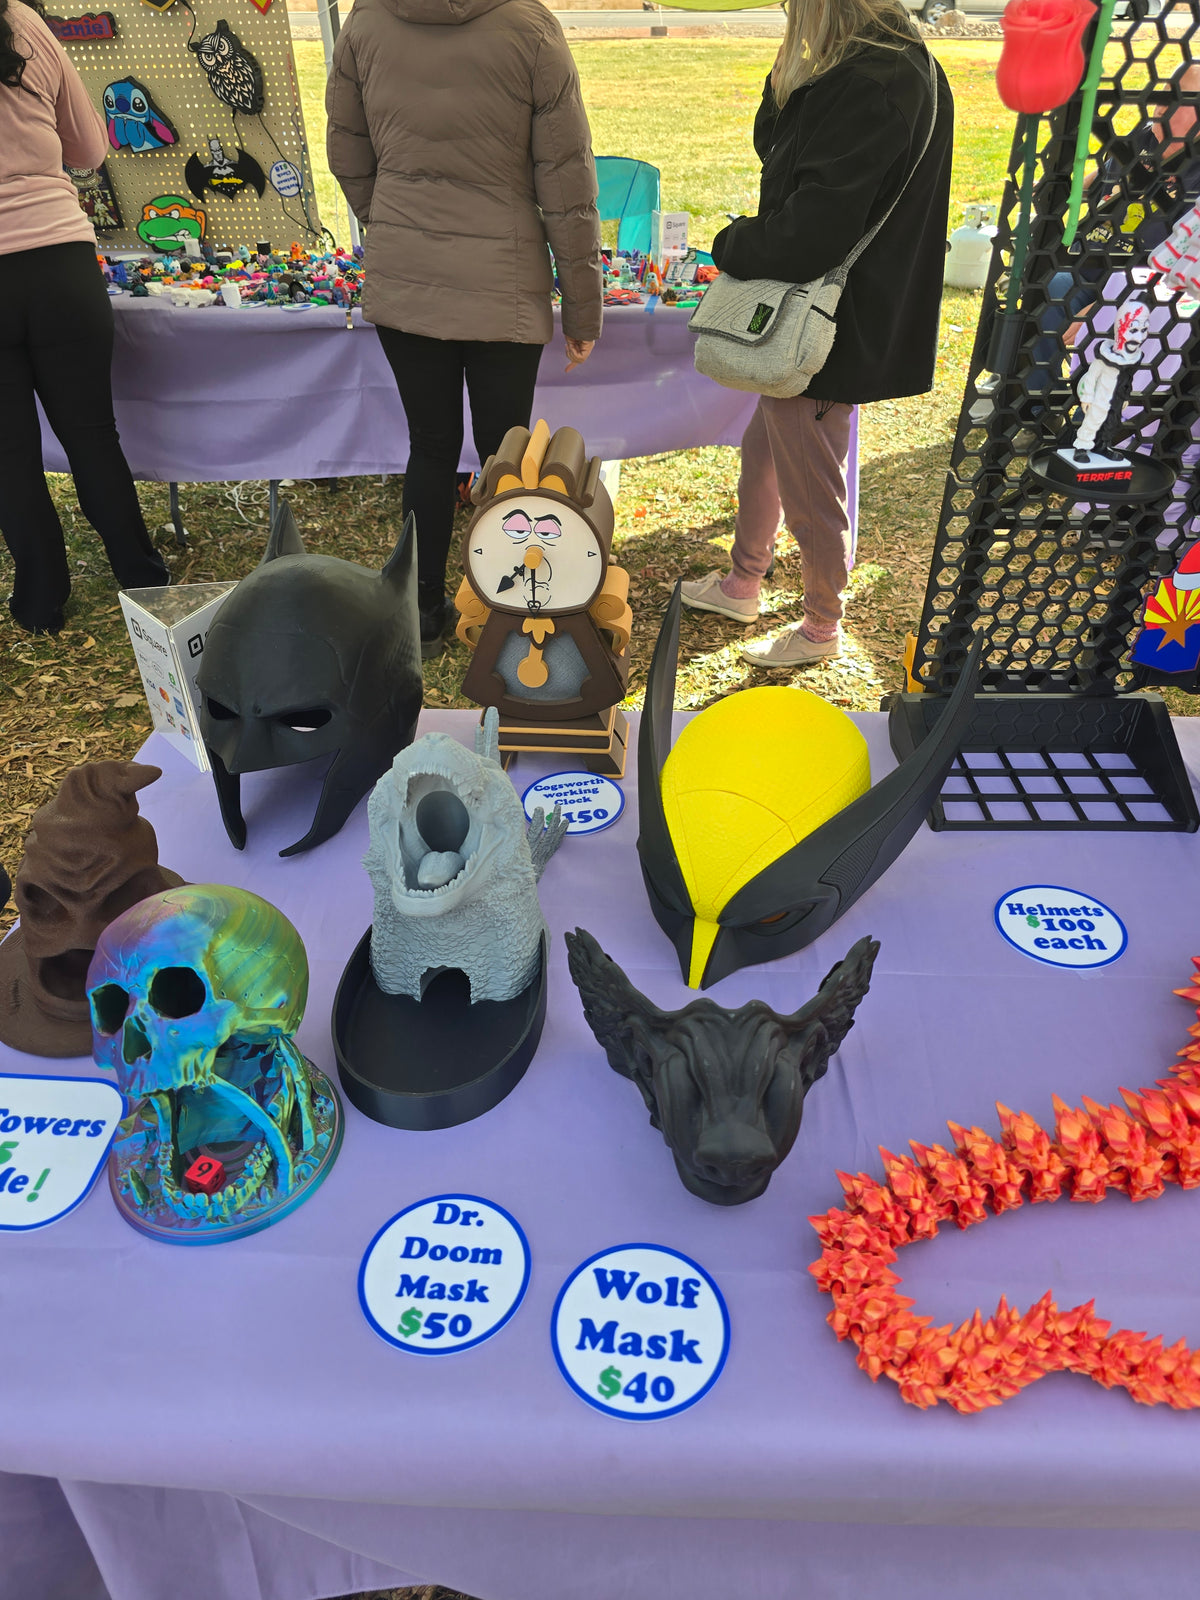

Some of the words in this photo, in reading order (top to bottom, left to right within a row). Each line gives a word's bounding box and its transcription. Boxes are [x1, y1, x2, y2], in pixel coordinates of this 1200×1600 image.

[1076, 471, 1133, 482] TERRIFIER
[142, 629, 168, 657] Square
[533, 778, 604, 791] Cogsworth
[543, 787, 600, 799] working
[554, 796, 592, 806] Clock
[1005, 903, 1104, 917] Helmets
[1026, 915, 1096, 932] $100
[1033, 934, 1108, 951] each
[196, 1162, 213, 1177] 9
[432, 1202, 485, 1227] Dr.
[400, 1236, 503, 1265] Doom
[395, 1274, 490, 1303] Mask
[592, 1267, 702, 1309] Wolf
[397, 1307, 473, 1340] $50
[575, 1317, 703, 1364] Mask
[597, 1365, 675, 1403] $40
